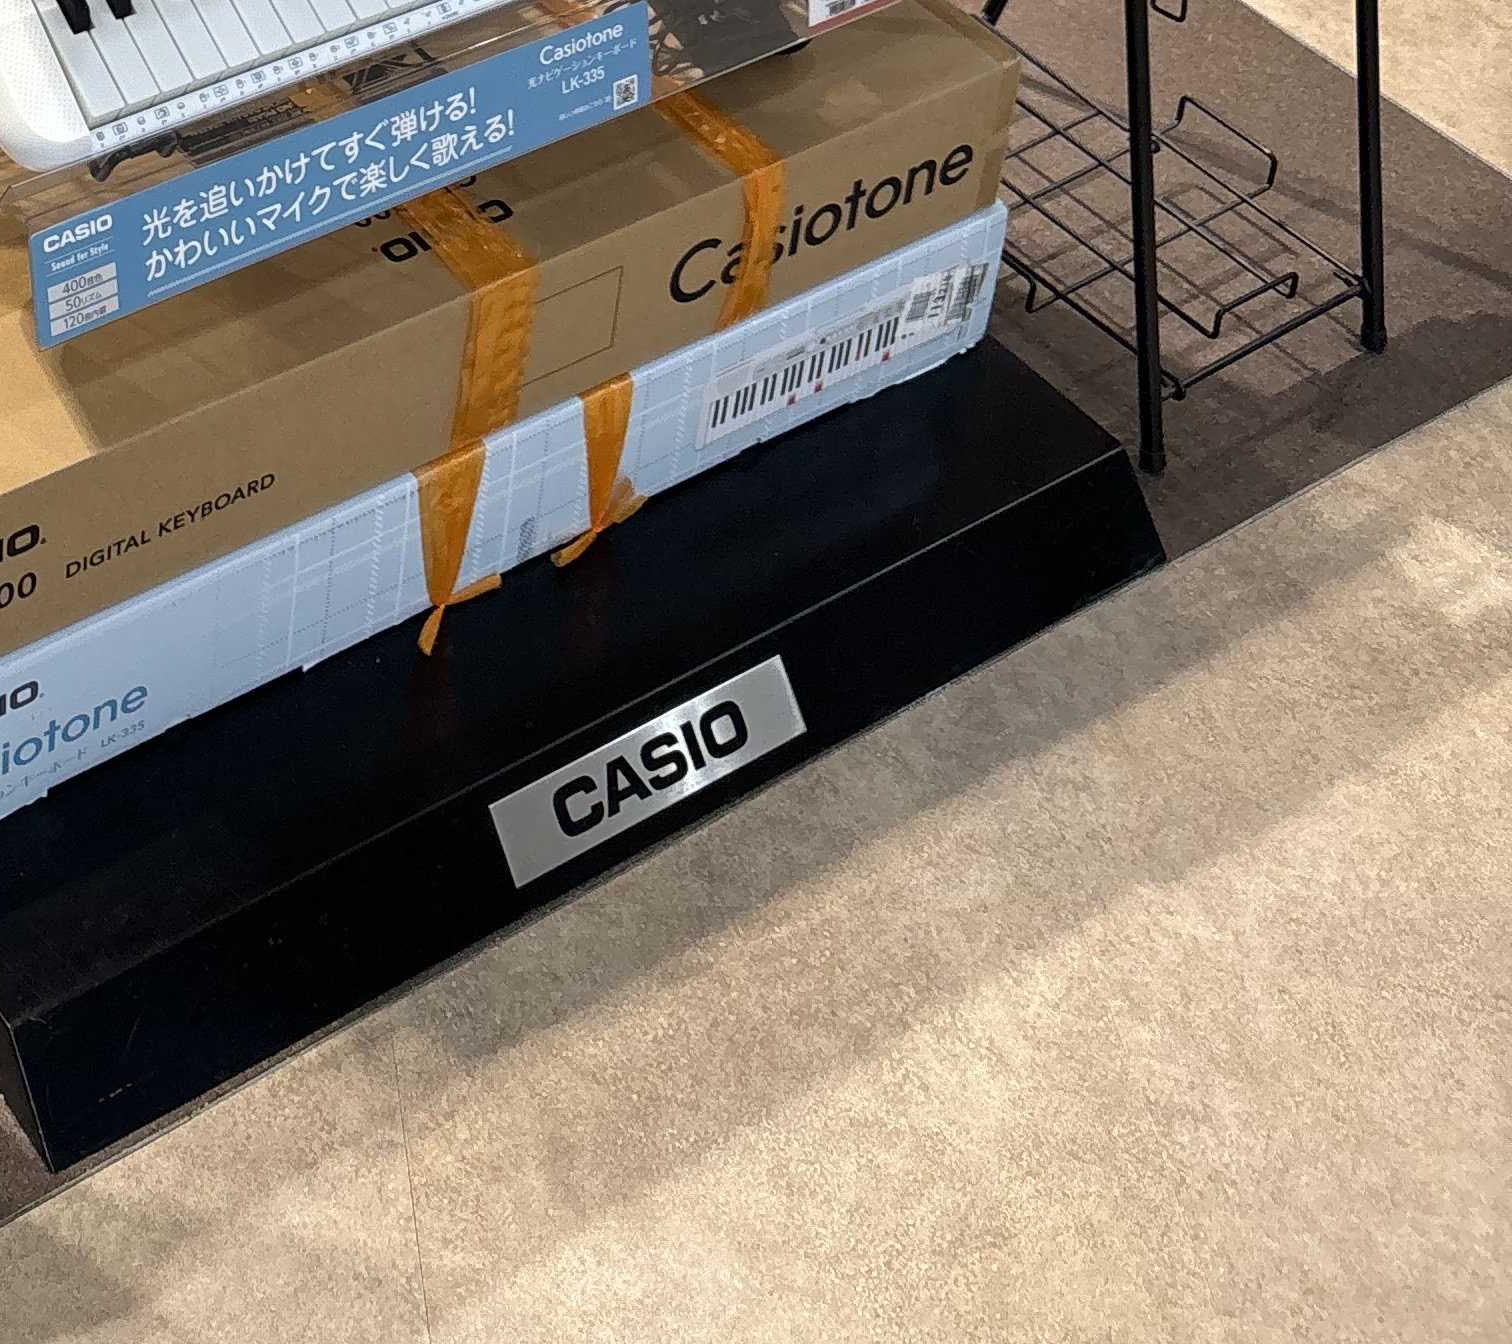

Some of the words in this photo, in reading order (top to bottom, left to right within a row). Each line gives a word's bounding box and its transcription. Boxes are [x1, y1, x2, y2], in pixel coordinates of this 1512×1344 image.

[527, 37, 638, 90] 光ナビゲーションキーボード
[539, 23, 625, 66] Casiotone
[561, 65, 606, 95] LK-335
[140, 86, 478, 248] 光を追いかけてすぐ弾ける!
[145, 108, 517, 283] かわいいマイクで楽しく歌える!
[42, 213, 114, 254] CASIO
[50, 255, 76, 272] Sound
[76, 251, 88, 264] for
[88, 242, 110, 259] Style
[61, 272, 104, 296] 400音色
[64, 291, 104, 311] 50リズム
[63, 304, 108, 330] 120曲内蔵
[64, 528, 152, 581] DIGITAL
[156, 472, 277, 538] KEYBOARD
[99, 720, 147, 751] LK-335
[551, 699, 749, 838] CASIO
